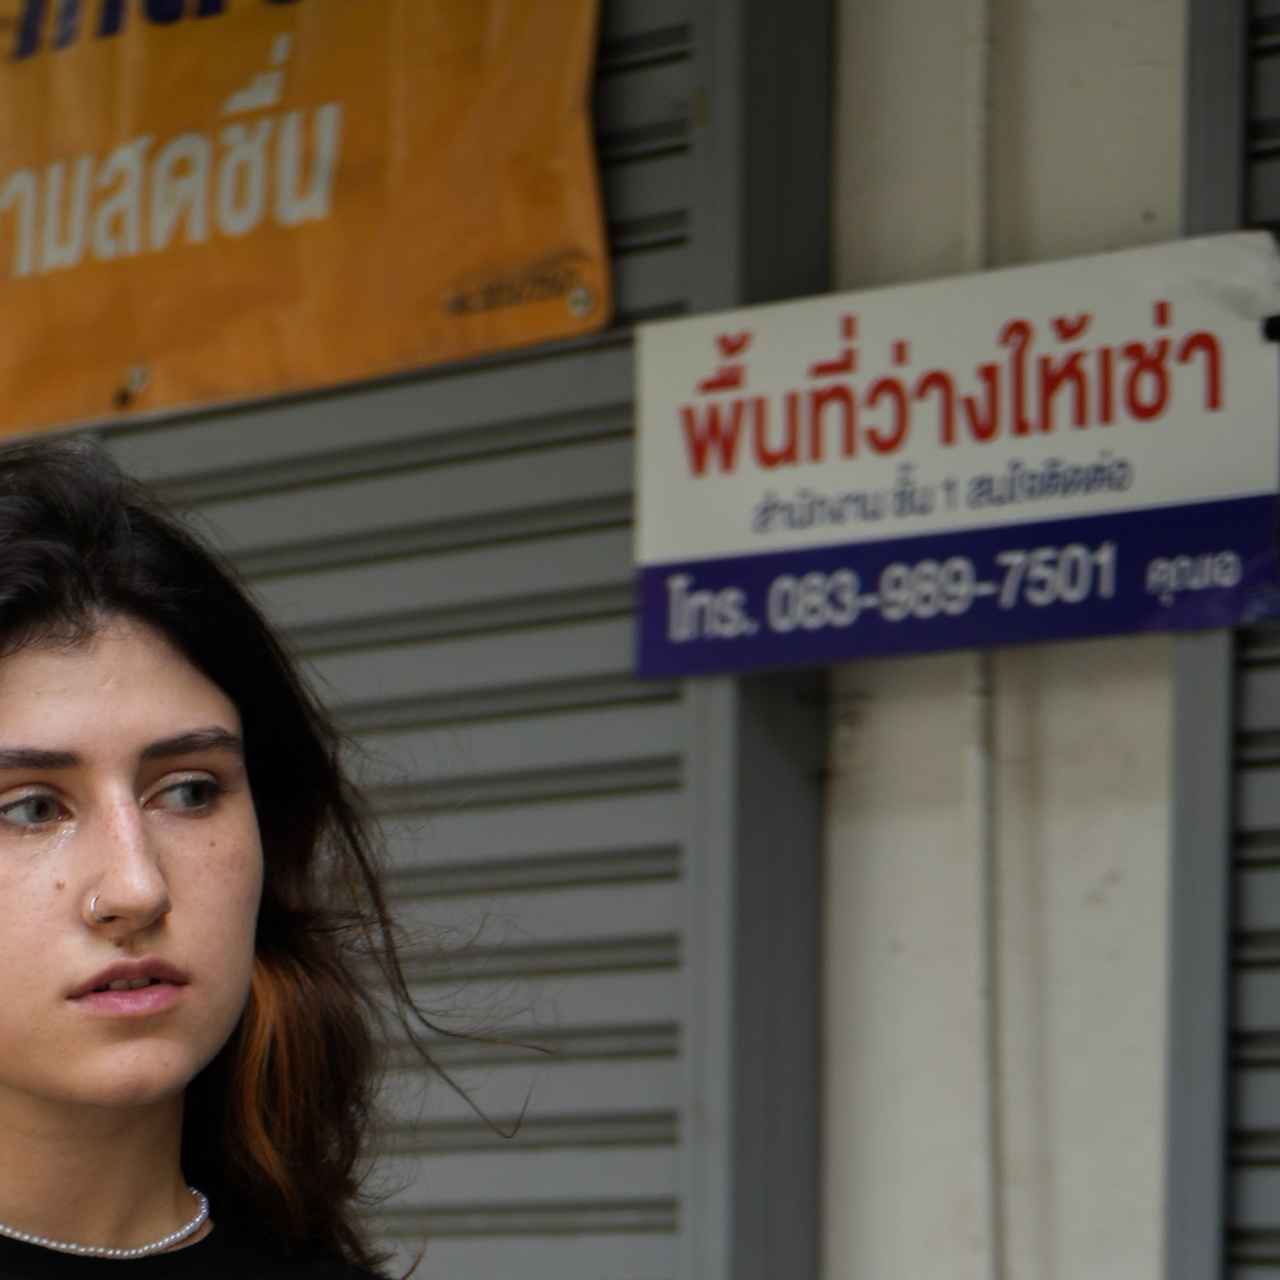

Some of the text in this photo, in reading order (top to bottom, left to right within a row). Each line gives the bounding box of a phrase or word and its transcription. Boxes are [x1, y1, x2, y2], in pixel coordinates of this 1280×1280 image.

[680, 300, 1224, 478] พื้นที่ว่างให้เช่า
[665, 572, 758, 643] โทร.
[766, 540, 1118, 634] 083-989-7501
